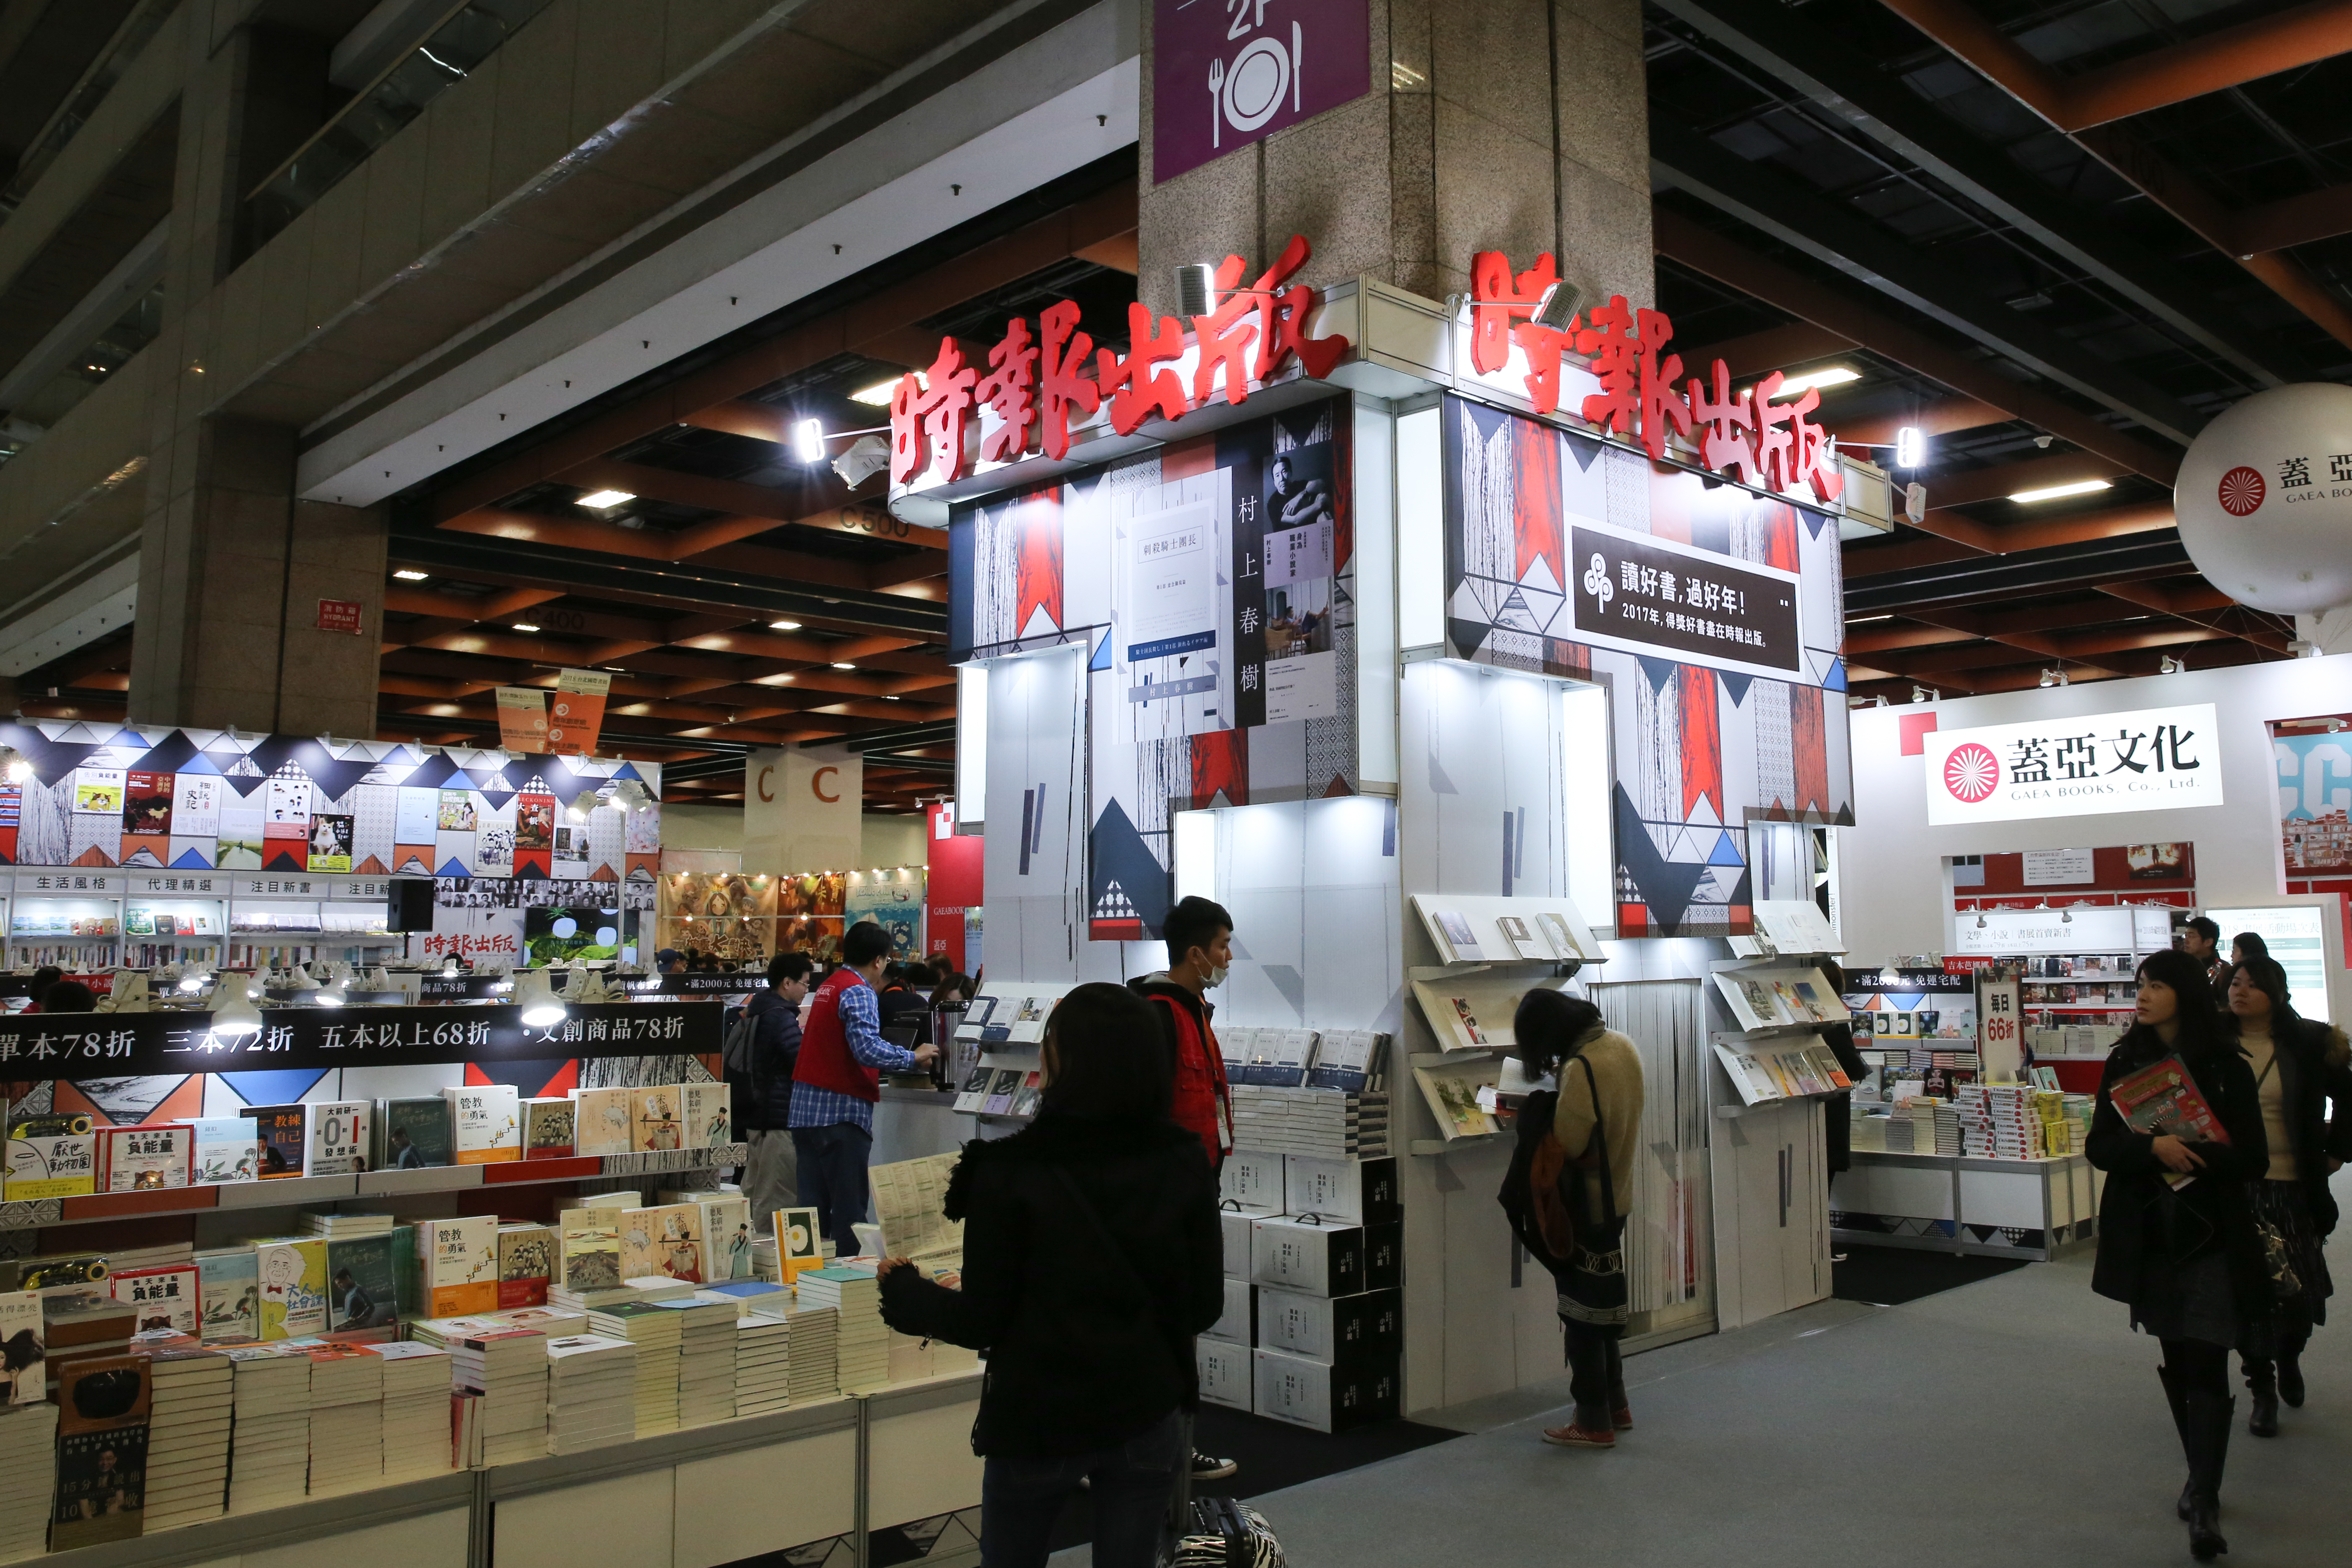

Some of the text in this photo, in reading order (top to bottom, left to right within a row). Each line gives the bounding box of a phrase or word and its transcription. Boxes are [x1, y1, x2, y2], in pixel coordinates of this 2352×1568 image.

[891, 234, 1349, 483] 時報出版
[1471, 250, 1843, 502] 時報出版
[2286, 491, 2325, 503] GAEA
[1143, 534, 1196, 556] 刺殺騎士團長
[1237, 495, 1259, 693] 村上春樹
[1620, 559, 1745, 615] 讀好書，過好年！
[323, 614, 355, 622] HYDRANT
[1622, 602, 1766, 648] 2017年，得獎好書盡在時報出版。
[1149, 681, 1194, 697] 村上春樹
[2006, 724, 2200, 785] 蓋亞文化
[757, 765, 774, 803] C
[812, 766, 840, 803] C
[2011, 776, 2201, 801] GAEA BOOKS, Co., Ltd.
[37, 876, 106, 889] 生活風格
[148, 878, 212, 891] 代理精選
[251, 881, 311, 893] 注目新書
[934, 906, 965, 915] GAEABOOK
[424, 933, 518, 956] 時報出版
[933, 939, 946, 951] 蓋亞
[1947, 960, 1990, 971] 吉本芭娜娜
[421, 982, 467, 993] 商品78折
[691, 977, 770, 989] 滿2000元 免運宅配
[1915, 973, 1961, 986] 免運宅配
[1990, 993, 2010, 1013] 每日
[319, 1020, 491, 1049] 五本以上68折
[535, 1015, 685, 1044] 文創商品78折
[1987, 1017, 2014, 1041] 66折
[0, 1029, 136, 1061] 單本78折
[163, 1025, 295, 1054] 三本72折
[460, 1096, 483, 1109] 管教
[2156, 1100, 2173, 1113] 2018
[327, 1107, 359, 1116] 大前研一
[461, 1110, 488, 1120] 的勇氣
[274, 1114, 301, 1128] 教練
[128, 1131, 173, 1141] 每天來點
[275, 1130, 301, 1144] 自己
[51, 1141, 84, 1158] 厭世
[127, 1139, 174, 1155] 負能量
[324, 1145, 358, 1157] 發想術
[49, 1153, 91, 1172] 動物園
[439, 1228, 462, 1243] 管教
[439, 1243, 466, 1254] 的勇氣
[132, 1275, 179, 1286] 每天來點
[132, 1283, 180, 1302] 負能量
[286, 1294, 324, 1311] 社會課
